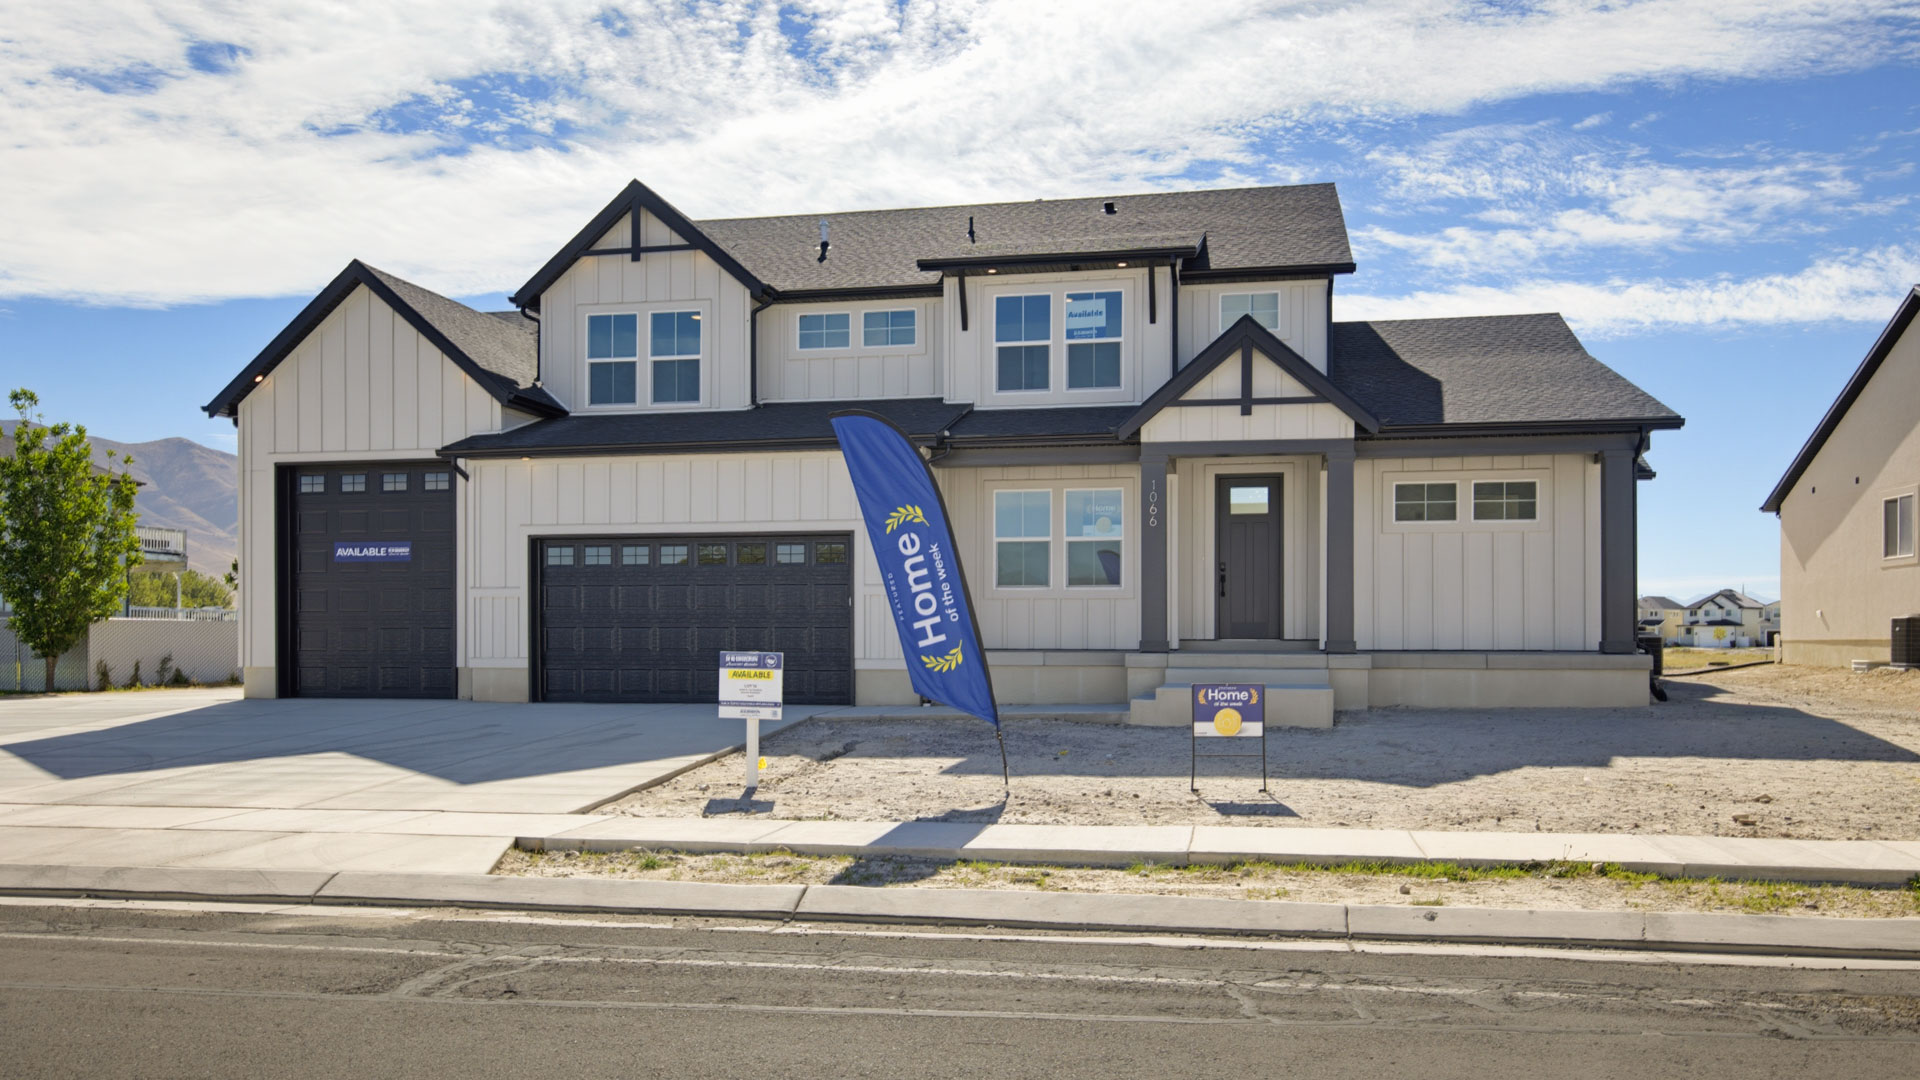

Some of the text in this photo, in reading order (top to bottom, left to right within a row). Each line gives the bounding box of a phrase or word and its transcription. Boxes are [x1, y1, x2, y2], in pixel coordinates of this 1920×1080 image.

[336, 547, 386, 556] AVAILABLE
[929, 542, 959, 622] of the week
[898, 532, 946, 648] Home
[732, 671, 771, 679] AVAILABLE
[1208, 689, 1249, 701] Home
